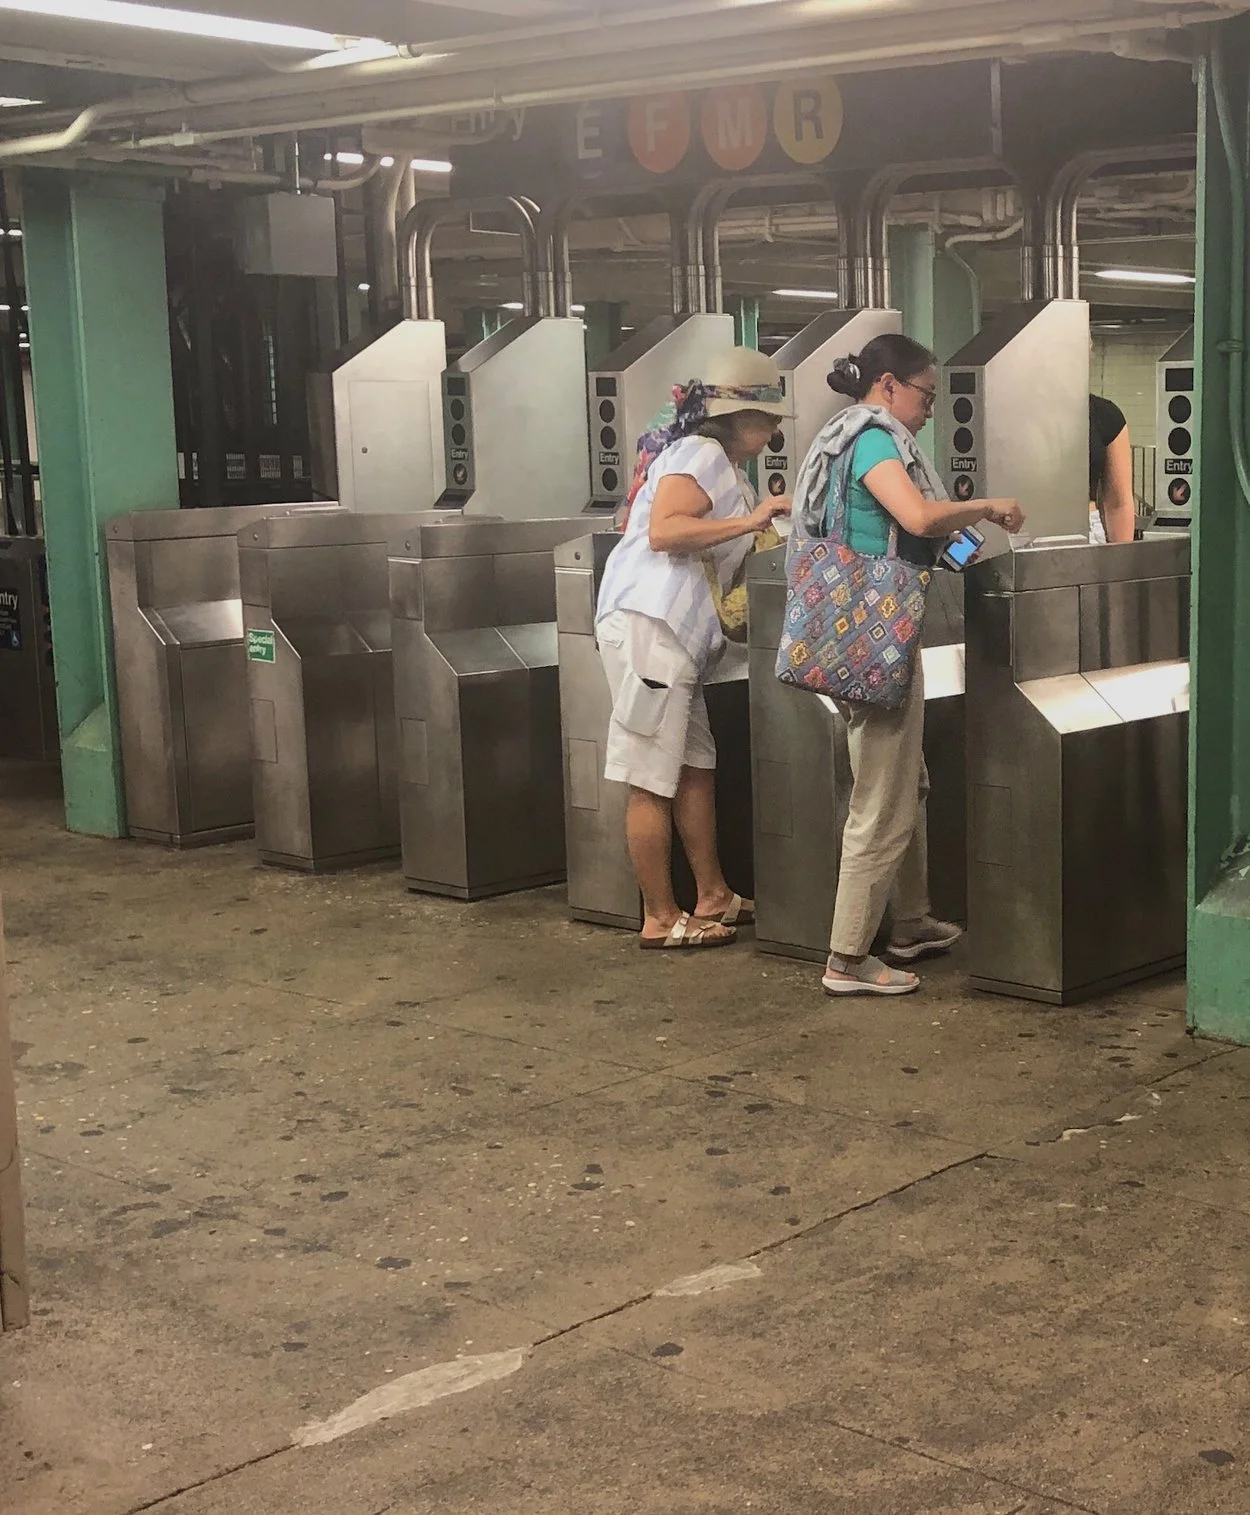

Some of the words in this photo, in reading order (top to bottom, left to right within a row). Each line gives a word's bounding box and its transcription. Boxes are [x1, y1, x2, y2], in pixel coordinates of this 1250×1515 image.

[451, 103, 525, 141] Enty
[577, 107, 602, 159] E
[646, 99, 672, 152] F
[717, 98, 754, 149] M
[793, 88, 824, 142] R
[451, 449, 468, 460] Entry
[600, 453, 619, 465] Entry
[766, 457, 787, 469] Entry
[952, 458, 977, 471] Entry
[1166, 460, 1192, 474] Entry
[249, 633, 273, 645] Special
[249, 645, 267, 656] entry
